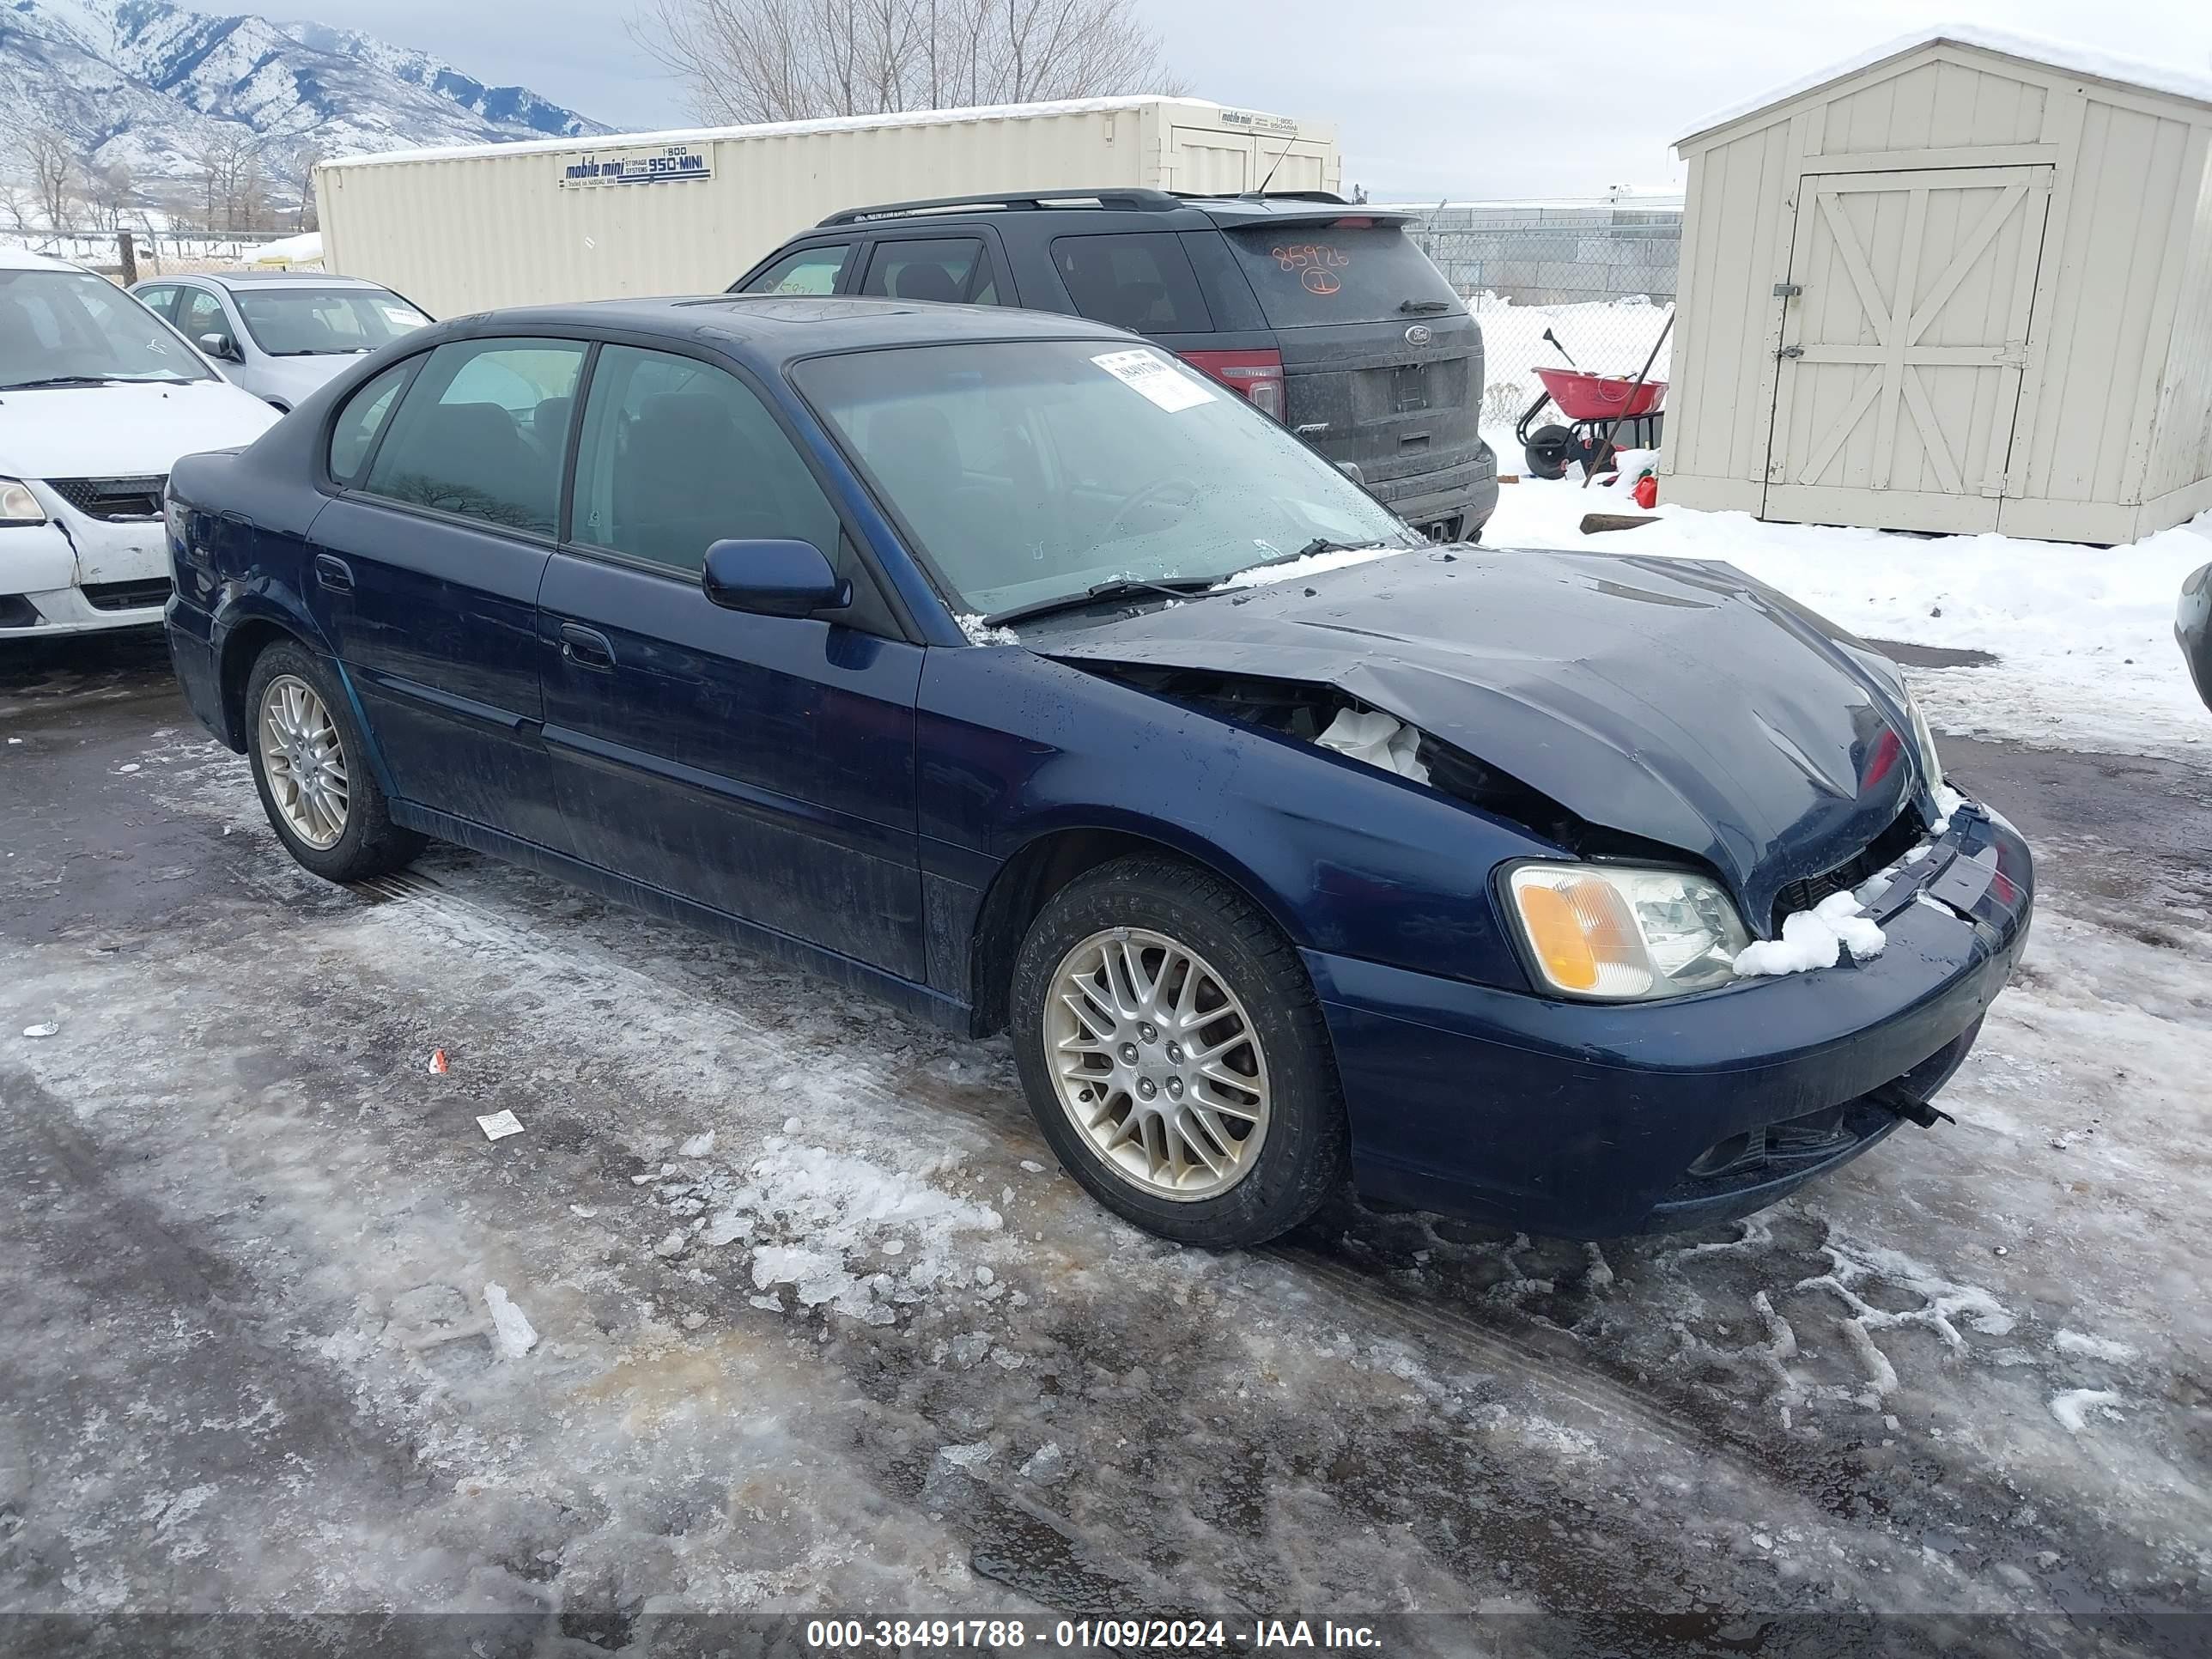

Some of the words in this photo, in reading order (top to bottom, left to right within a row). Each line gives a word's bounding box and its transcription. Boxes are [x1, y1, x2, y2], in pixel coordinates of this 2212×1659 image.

[1222, 111, 1240, 124] mobile
[1240, 114, 1252, 125] mini
[566, 155, 599, 179] mobile
[601, 158, 625, 177] mini
[625, 159, 647, 167] STORAGE
[1272, 246, 1349, 271] 85926
